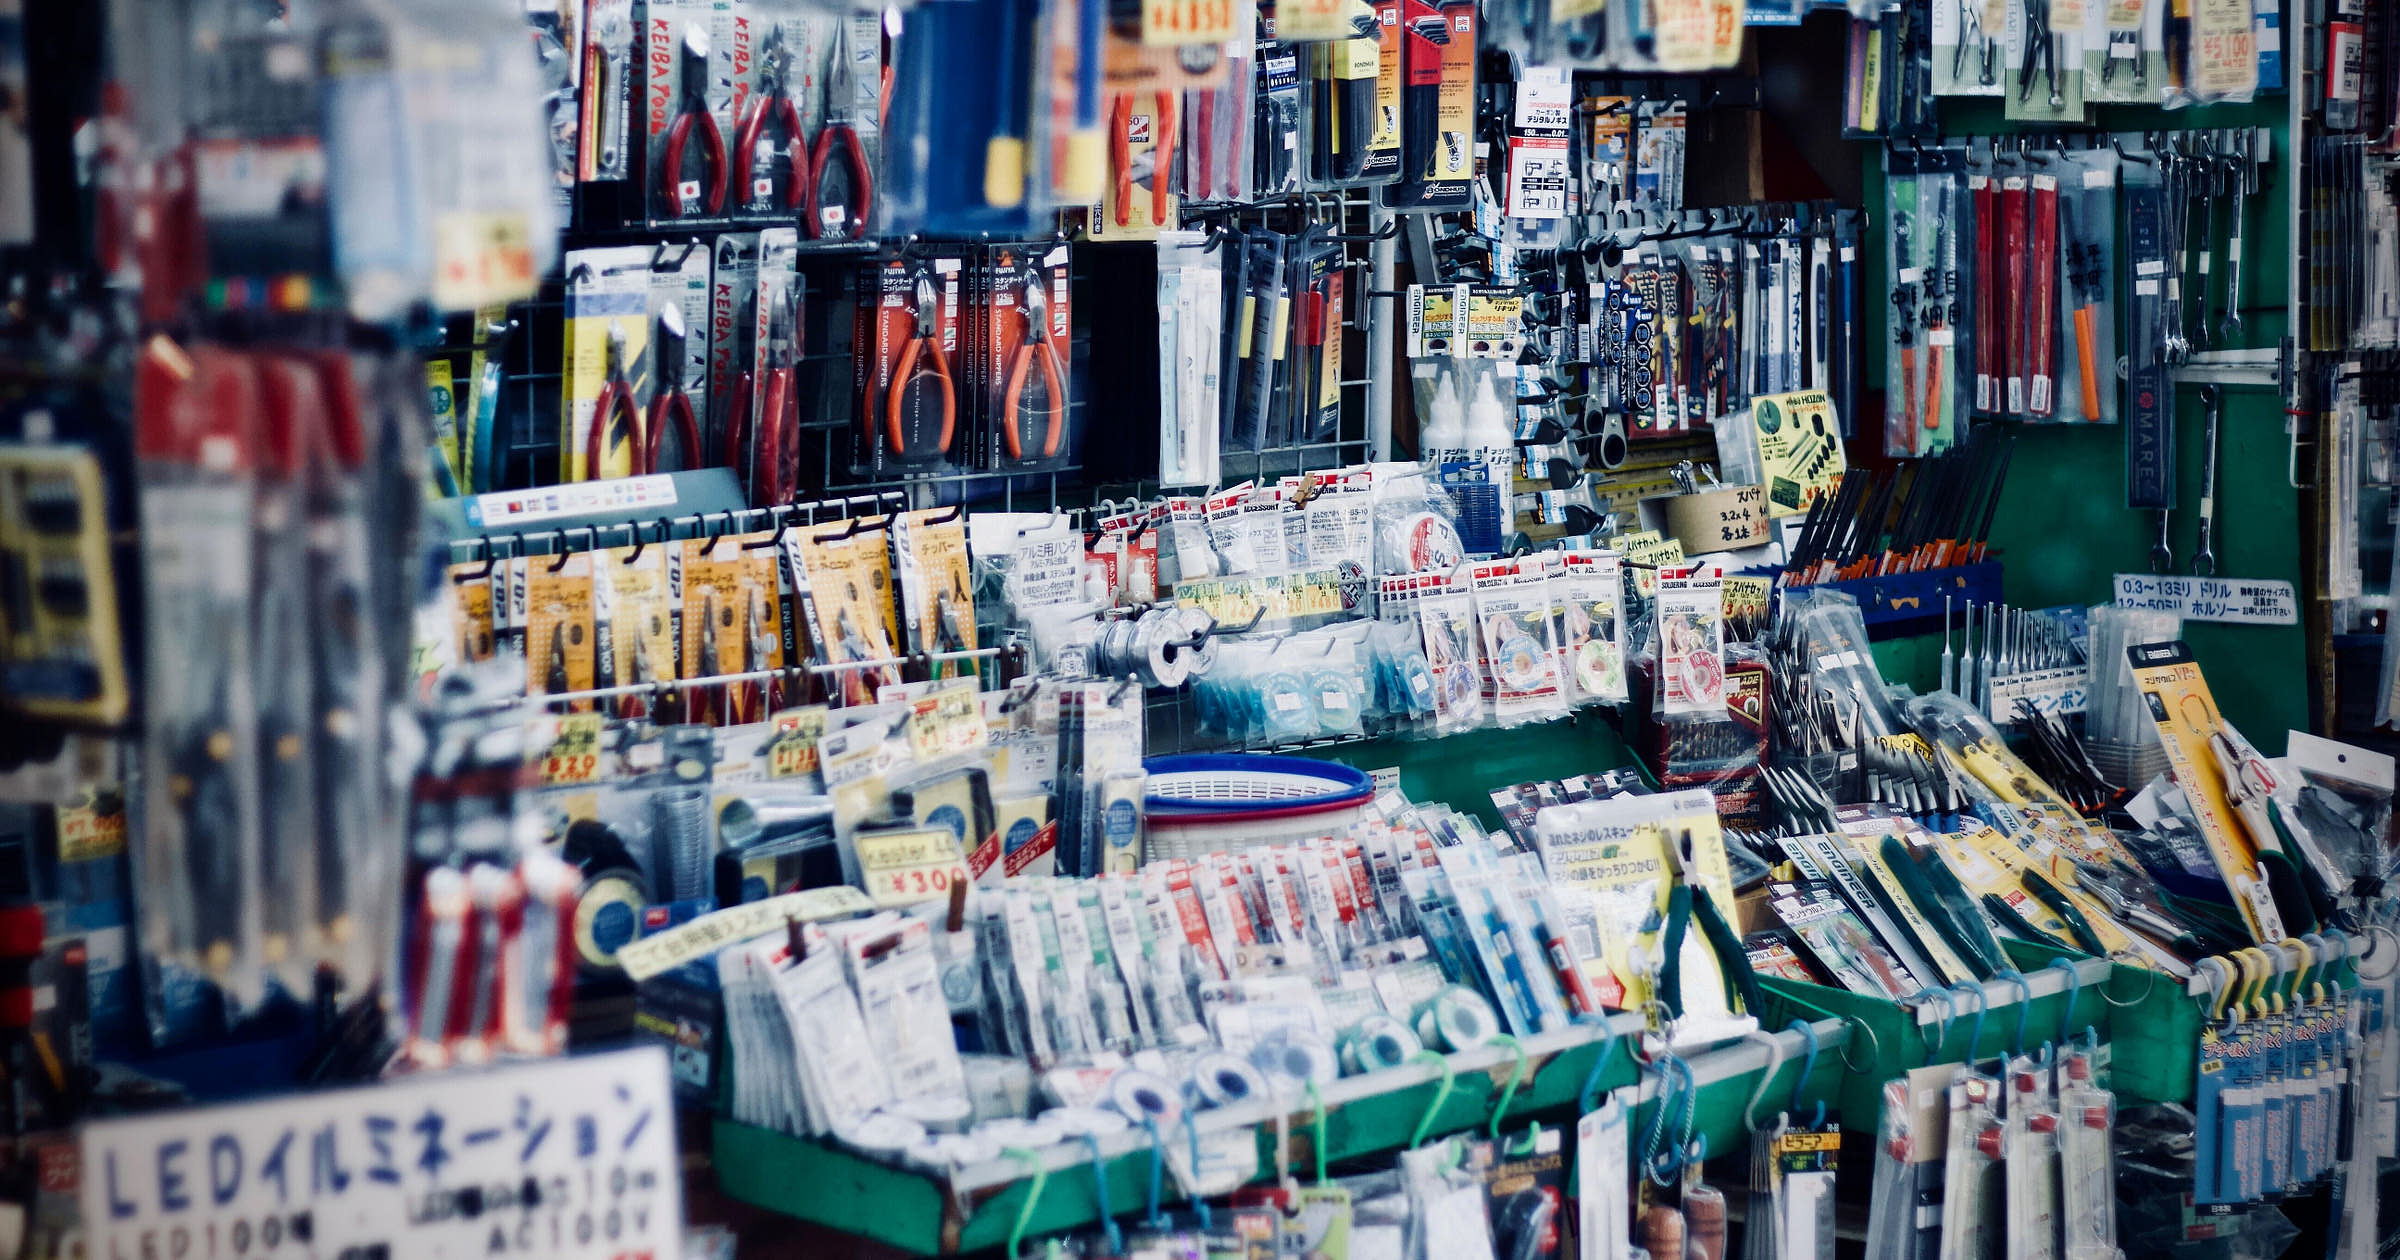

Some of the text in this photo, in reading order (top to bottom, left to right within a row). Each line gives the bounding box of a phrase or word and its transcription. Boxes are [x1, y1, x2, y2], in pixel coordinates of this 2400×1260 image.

[651, 18, 671, 79] KEIBA
[734, 16, 750, 75] KEIBA
[1527, 115, 1568, 124] デジタルノギス
[1423, 182, 1466, 198] BONDHUS
[1412, 289, 1421, 334] ENGINEER
[1458, 289, 1467, 334] ENGINEER
[880, 354, 888, 388] NIPPERS
[1211, 509, 1239, 520] SOLDERING
[514, 568, 525, 615] TOP
[671, 552, 682, 598] TOP
[1661, 581, 1688, 589] SOLDERING
[2200, 581, 2232, 598] ドリル
[2192, 602, 2240, 617] ホルソー
[1817, 841, 1876, 910] ENGINEER
